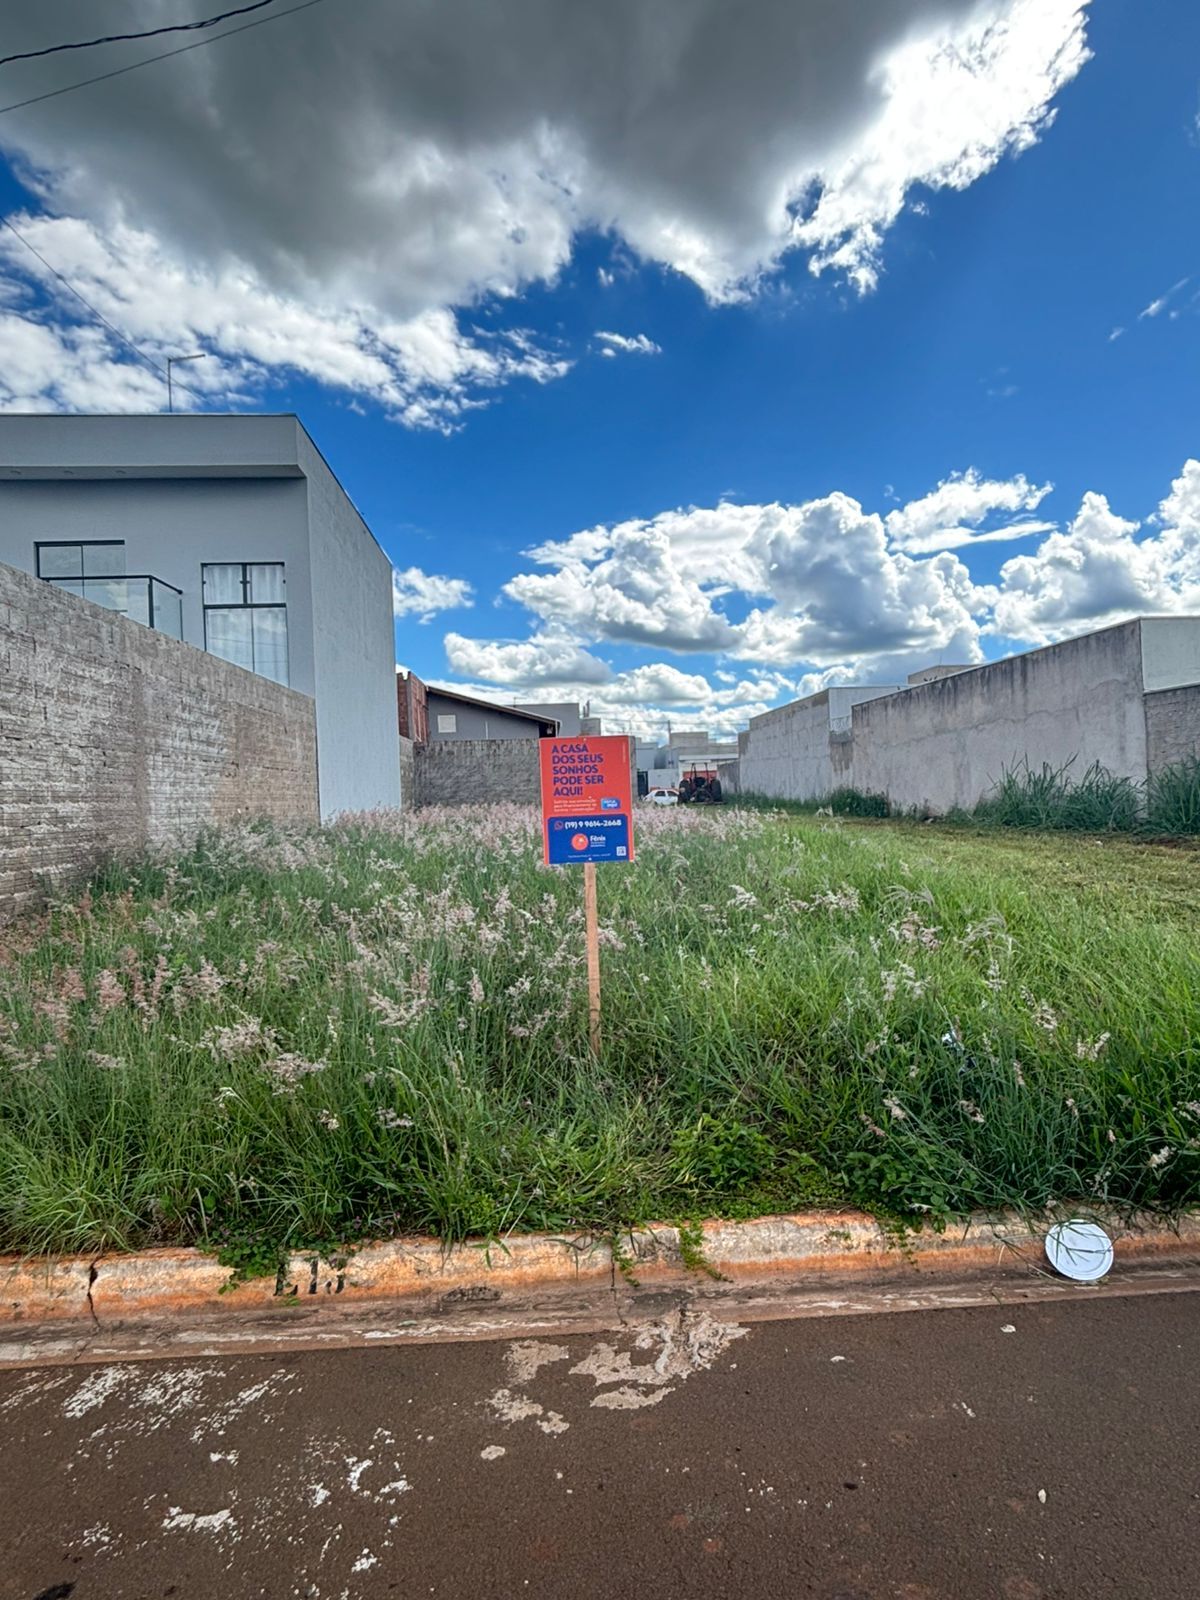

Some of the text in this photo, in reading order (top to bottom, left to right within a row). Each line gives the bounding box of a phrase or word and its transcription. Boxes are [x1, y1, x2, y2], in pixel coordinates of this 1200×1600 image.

[552, 743, 588, 753] A CASA
[552, 753, 604, 764] DOS SEUS
[553, 764, 599, 775] SONHOS
[553, 774, 604, 785] PODE SER
[554, 785, 583, 796] AQUI!
[565, 821, 578, 830] (19)
